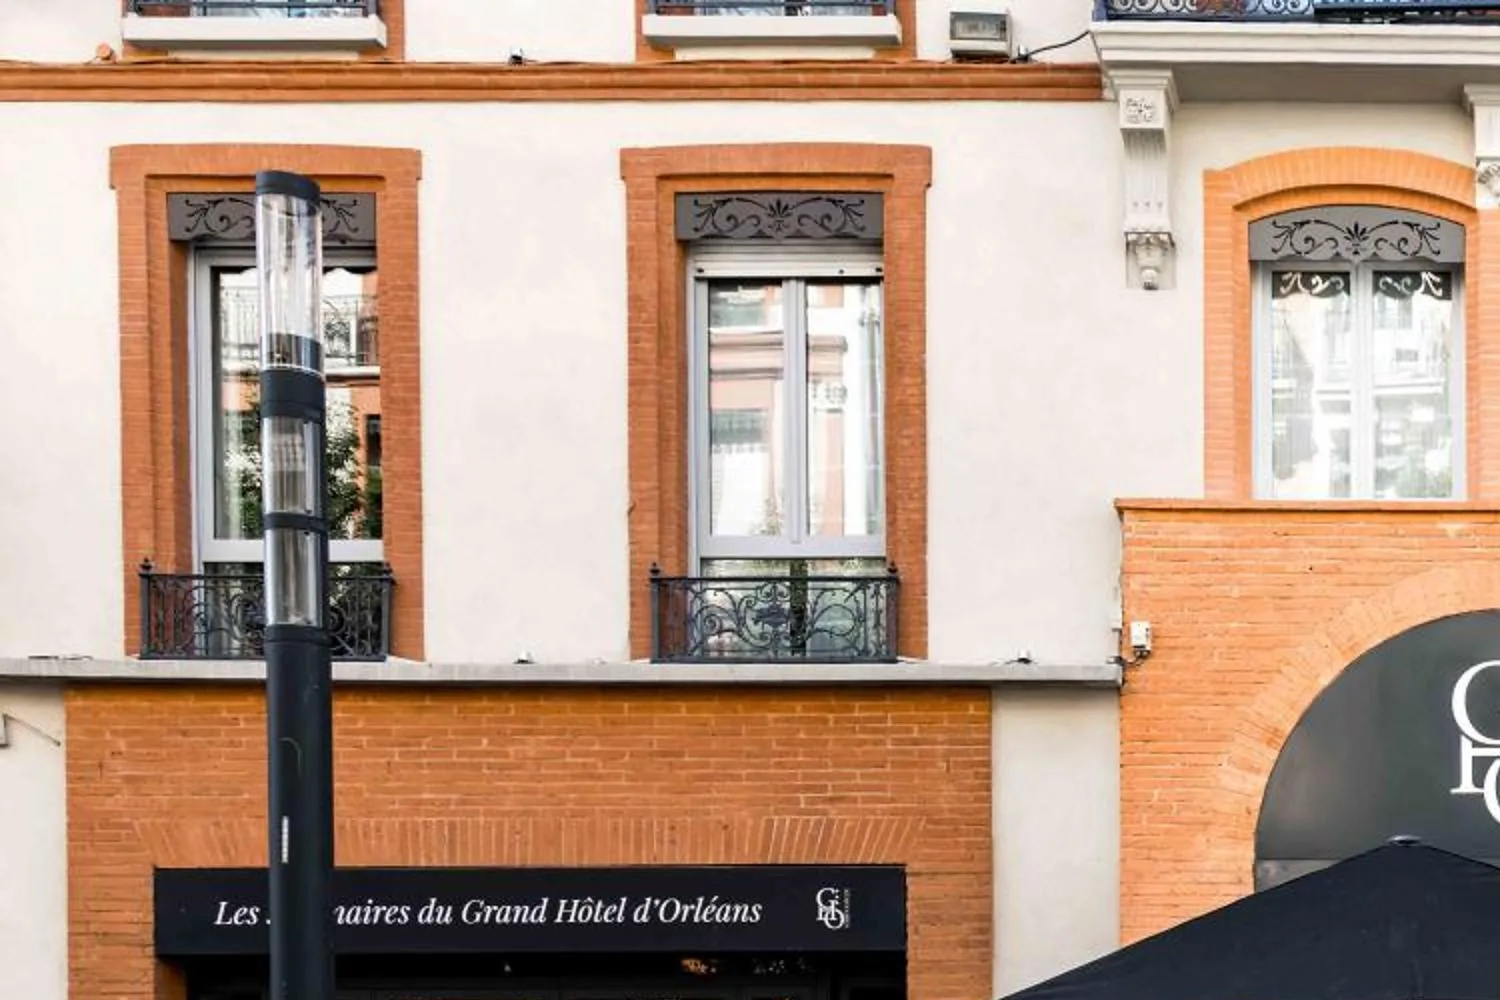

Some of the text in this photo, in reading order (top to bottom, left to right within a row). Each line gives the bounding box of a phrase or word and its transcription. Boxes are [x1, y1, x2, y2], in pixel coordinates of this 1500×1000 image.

[214, 901, 260, 925] Les
[417, 897, 453, 925] du
[461, 897, 549, 925] Grand
[554, 897, 626, 924] Hôtel
[633, 896, 763, 924] d'Orléans
